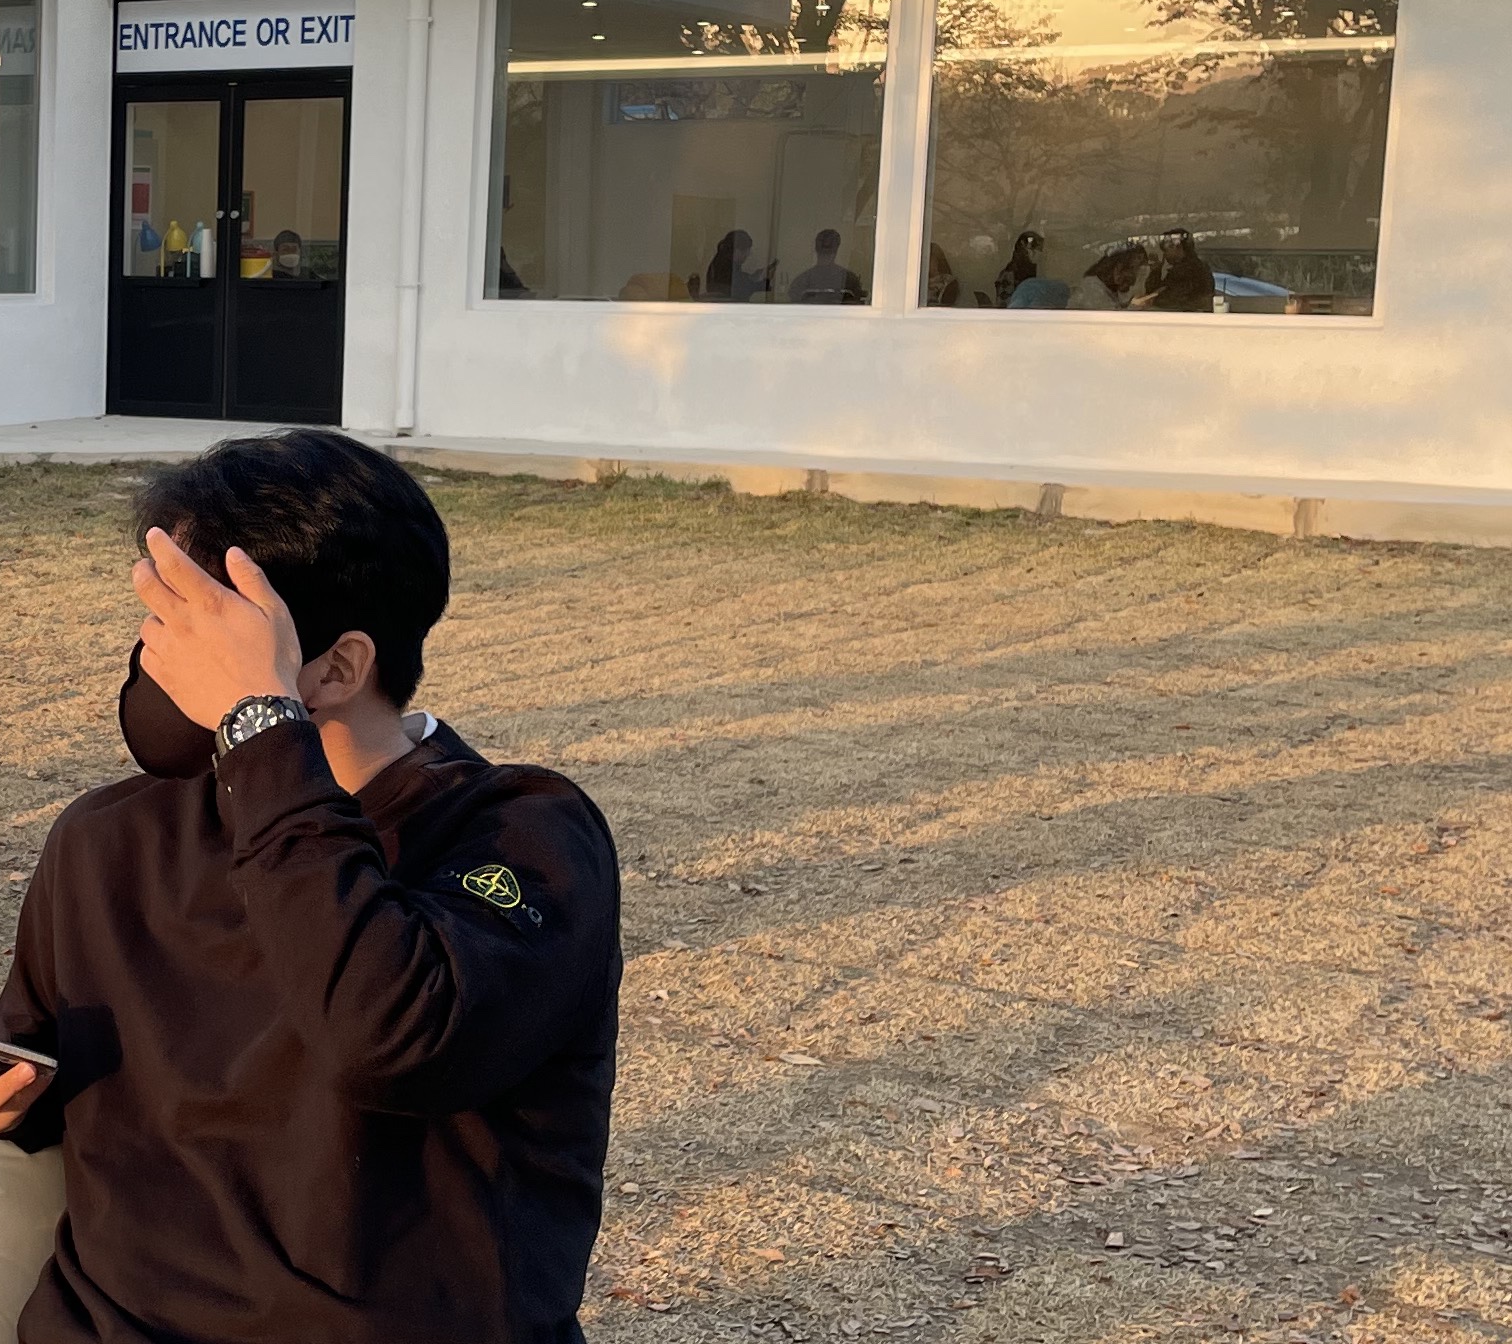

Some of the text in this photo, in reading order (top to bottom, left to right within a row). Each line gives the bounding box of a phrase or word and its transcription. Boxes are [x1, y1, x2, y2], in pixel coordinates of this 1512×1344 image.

[119, 15, 355, 50] ENTRANCE OR EXIT
